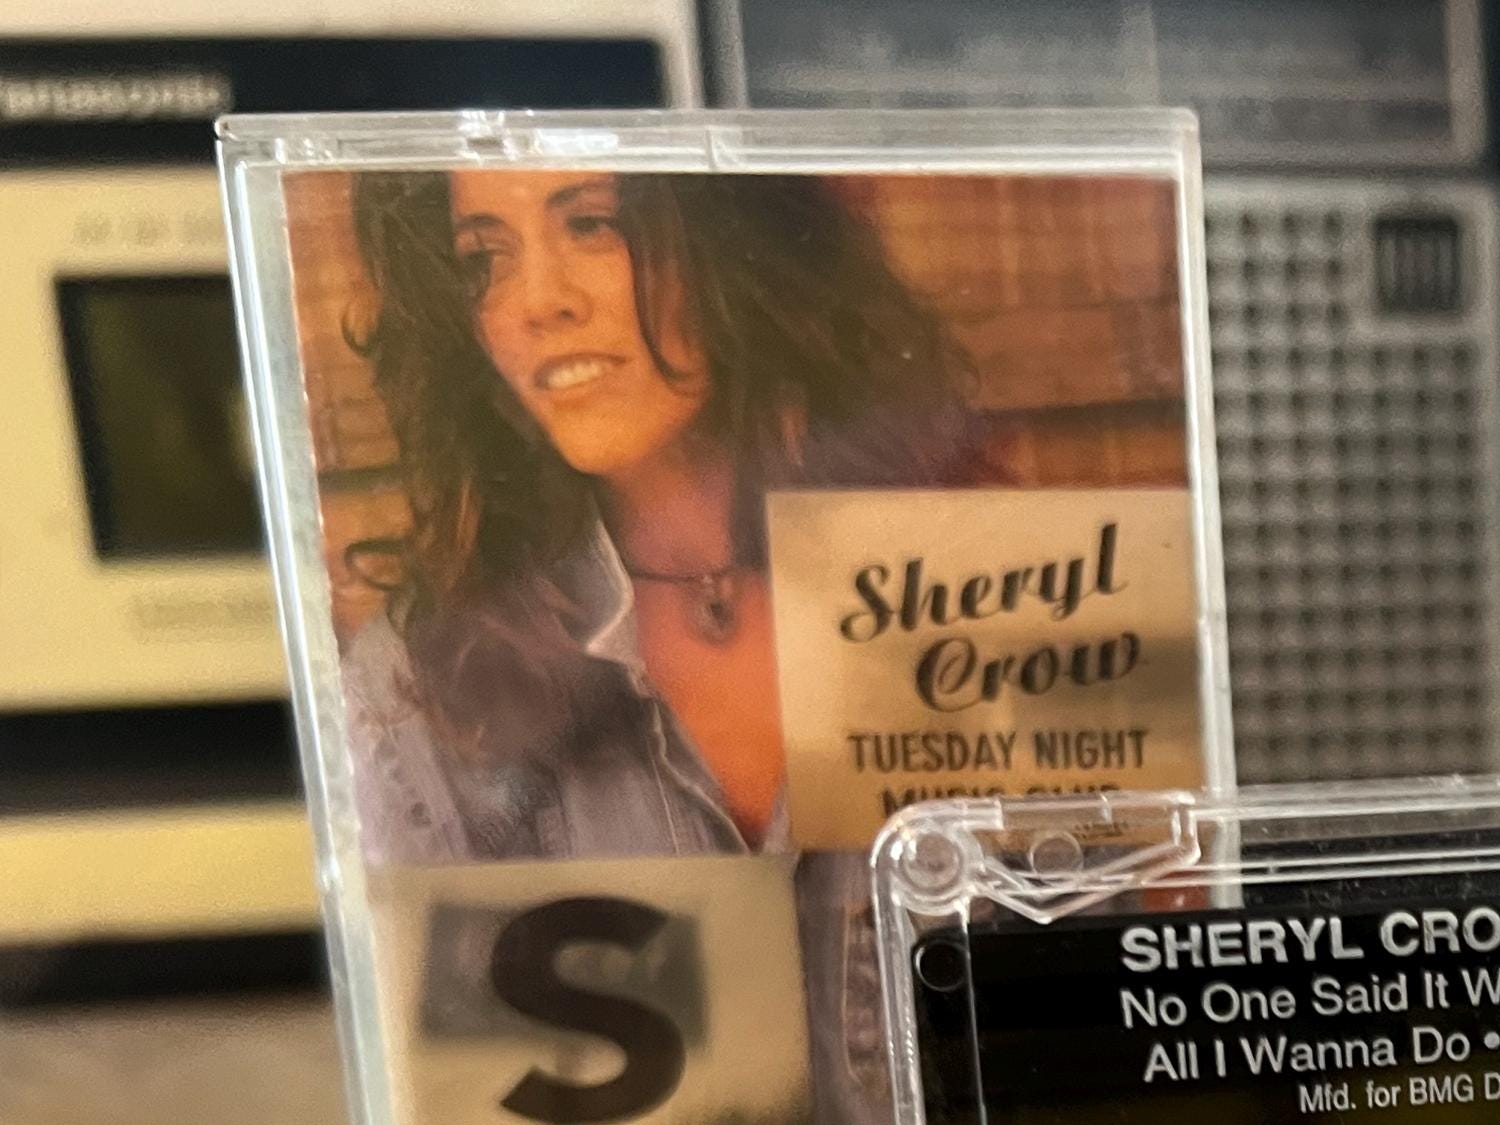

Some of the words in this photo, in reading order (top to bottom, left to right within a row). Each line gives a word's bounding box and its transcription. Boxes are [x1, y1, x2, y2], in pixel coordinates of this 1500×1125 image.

[839, 522, 1129, 642] Sheryl
[915, 631, 1141, 713] Crow
[847, 729, 1018, 774] TUESDAY
[1033, 728, 1149, 772] NIGHT
[1121, 916, 1364, 972] SHERYL
[1121, 988, 1187, 1029] No
[1202, 981, 1296, 1025] One
[1311, 974, 1408, 1017] Said
[1424, 973, 1449, 1009] It
[1143, 1041, 1198, 1083] All
[1215, 1040, 1226, 1076] I
[1240, 1034, 1397, 1074] Wanna
[1412, 1026, 1470, 1063] Do
[1300, 1082, 1356, 1113] Mfd.
[1366, 1080, 1401, 1108] for
[1409, 1076, 1474, 1104] BMG
